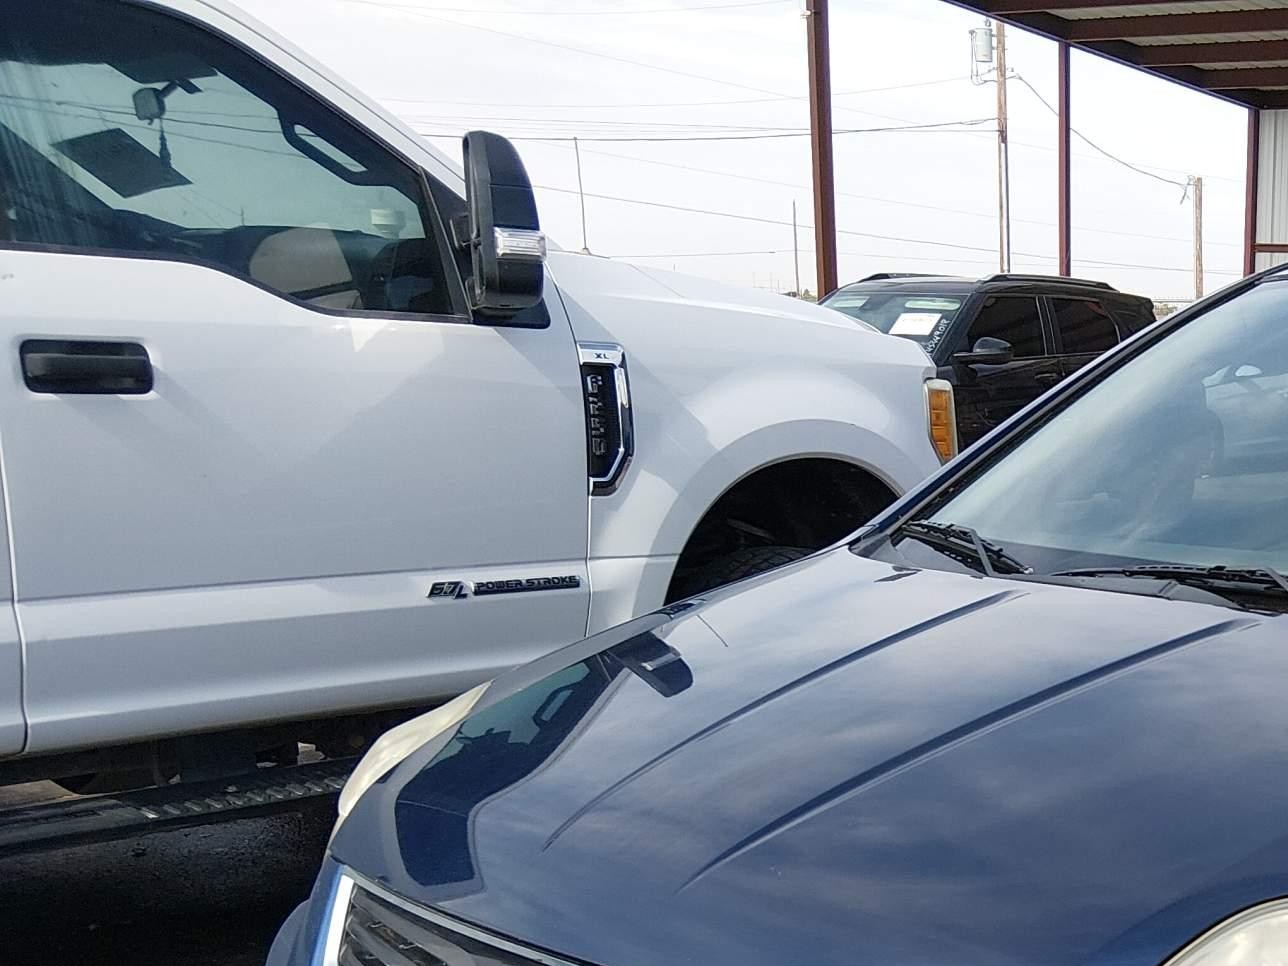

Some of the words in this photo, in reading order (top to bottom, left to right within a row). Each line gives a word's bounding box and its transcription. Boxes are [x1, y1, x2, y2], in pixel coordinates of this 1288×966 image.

[594, 352, 609, 360] XL
[476, 579, 523, 592] POWER
[527, 575, 577, 588] STROKE
